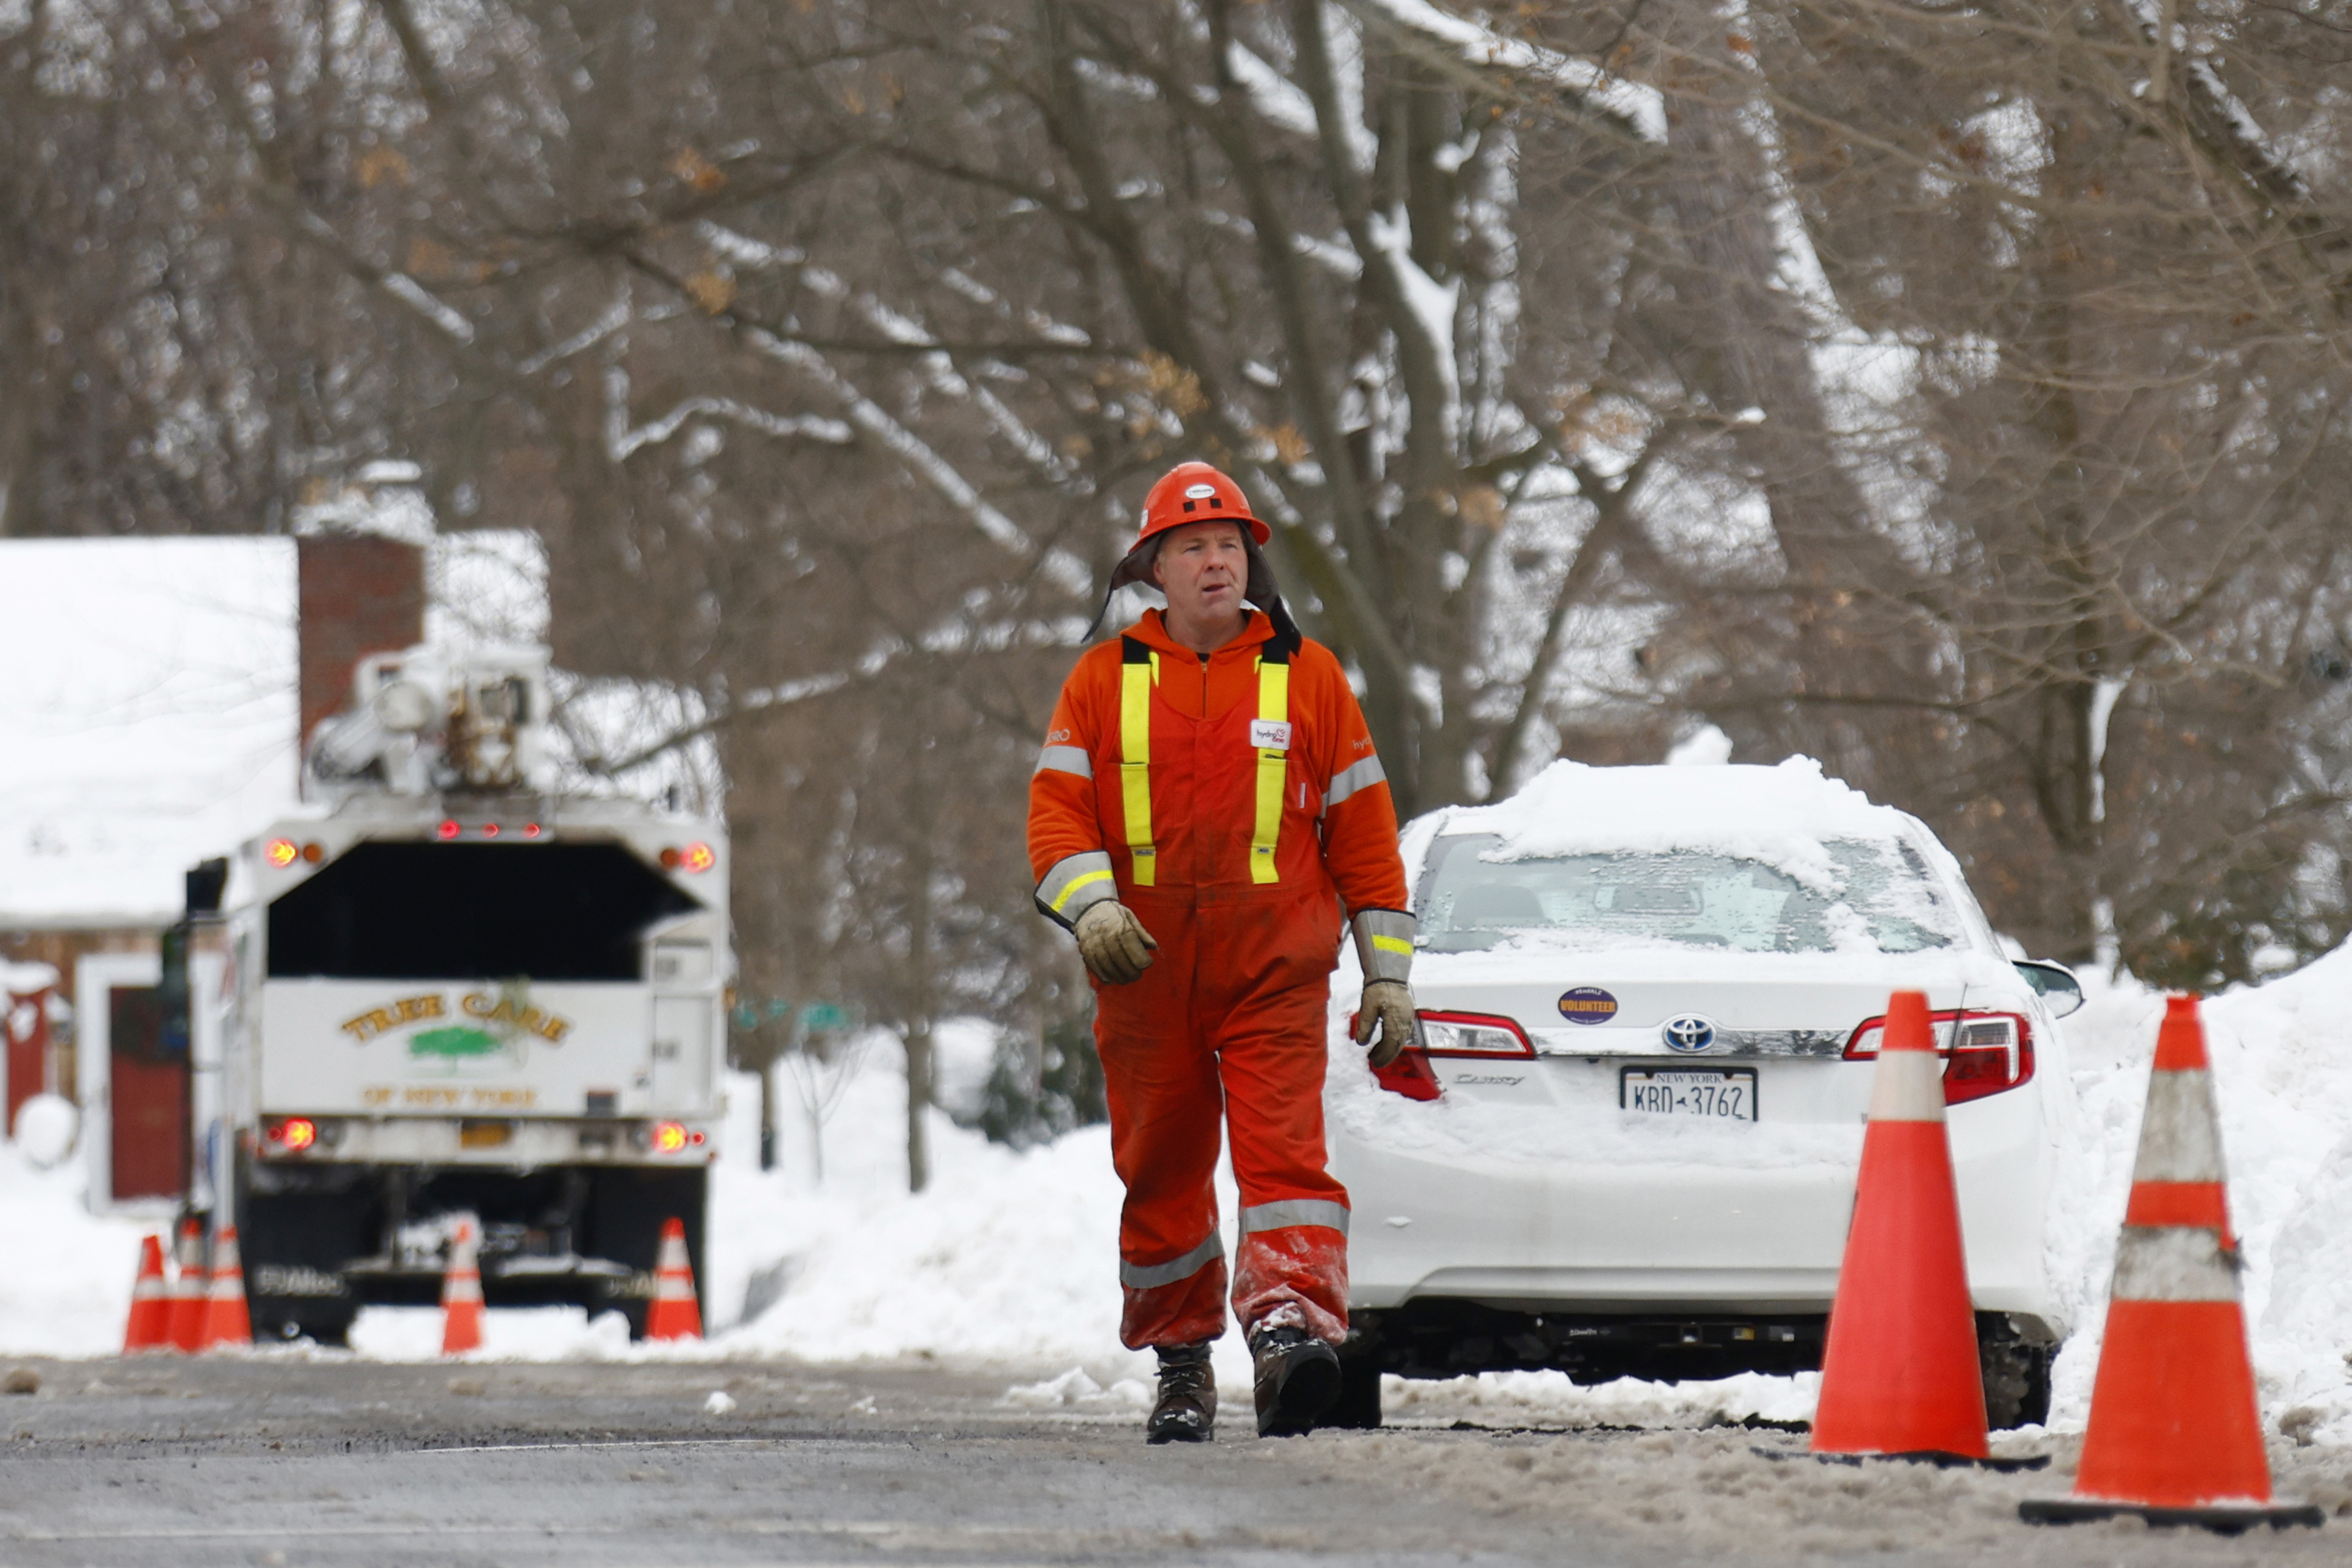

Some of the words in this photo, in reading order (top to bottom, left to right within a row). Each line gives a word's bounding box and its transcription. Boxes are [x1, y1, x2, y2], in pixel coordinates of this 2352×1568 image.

[1256, 728, 1277, 739] hydro
[1561, 1000, 1615, 1012] VOLUNTEER
[342, 994, 443, 1042] TREE
[462, 993, 570, 1043] CARE
[1656, 1073, 1688, 1083] NEW
[1690, 1073, 1722, 1083] YORK
[364, 1088, 393, 1105] OF
[403, 1087, 461, 1105] NEW
[472, 1087, 537, 1105] YORK
